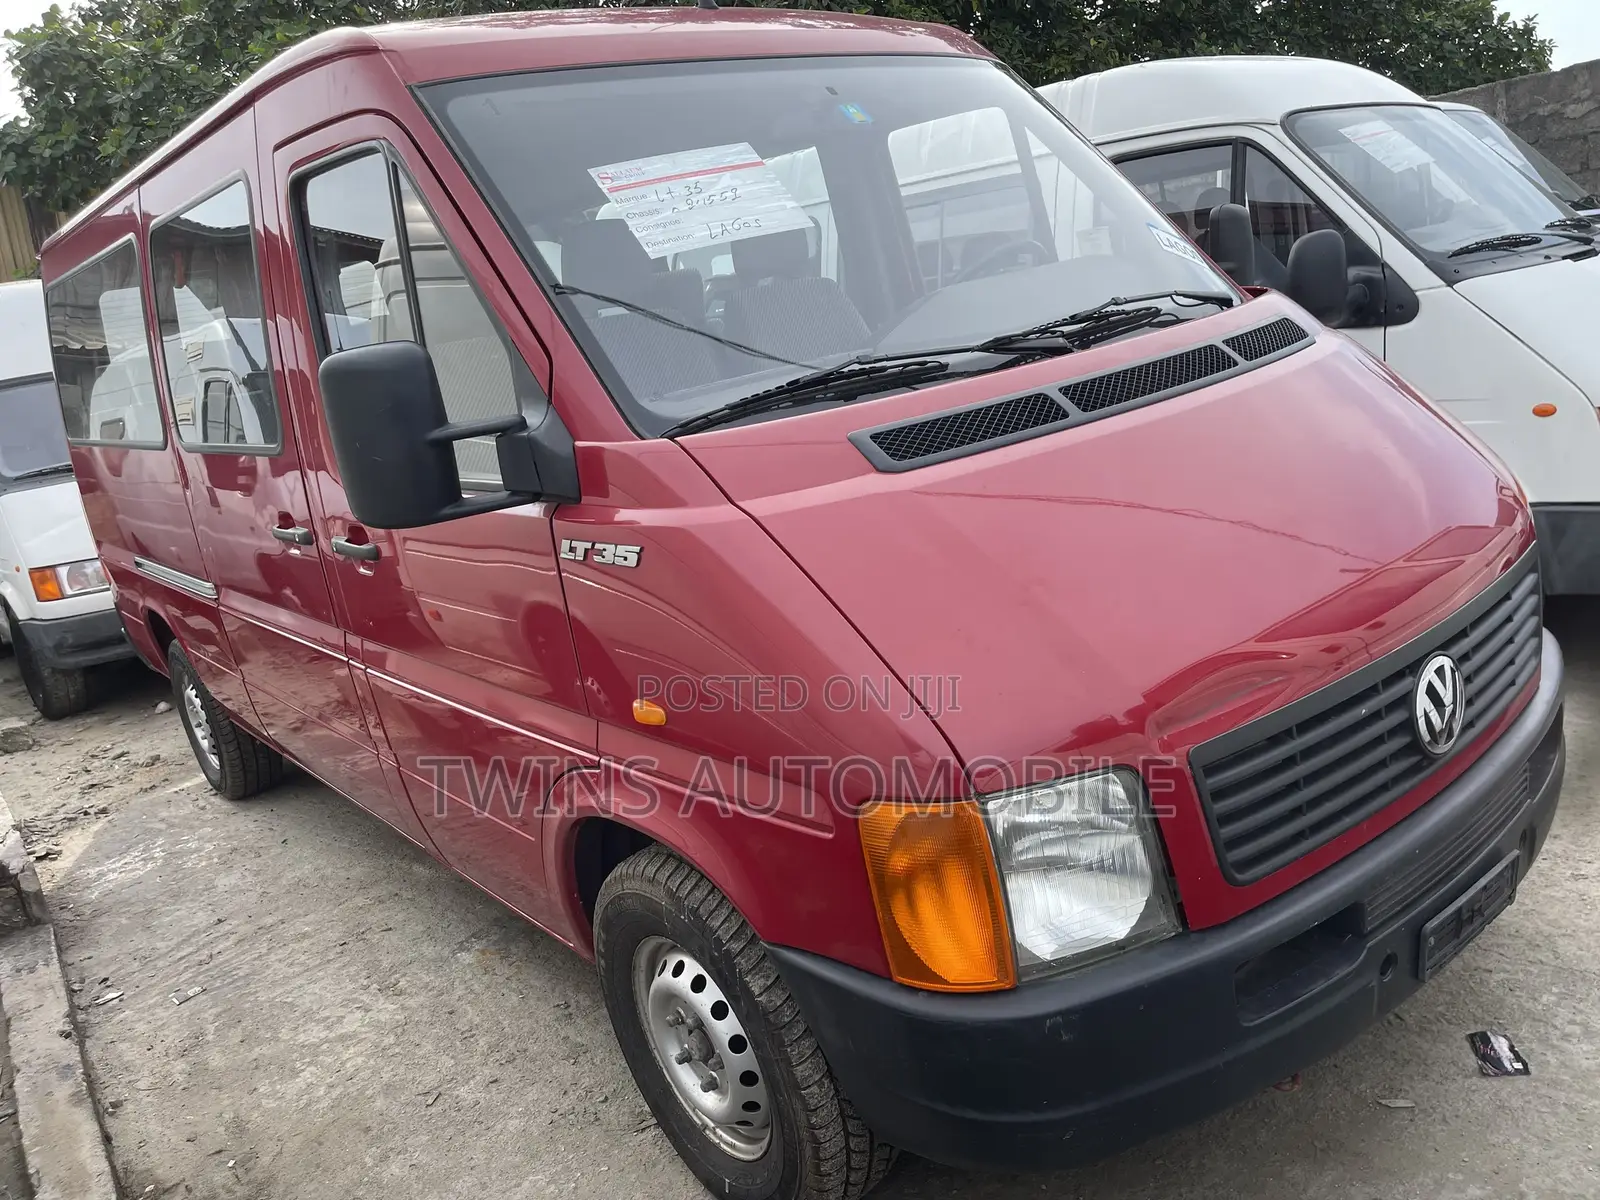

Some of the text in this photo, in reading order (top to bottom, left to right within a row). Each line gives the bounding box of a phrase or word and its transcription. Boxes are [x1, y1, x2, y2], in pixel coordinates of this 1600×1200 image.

[625, 207, 663, 220] Chassis:
[645, 232, 697, 249] Destination:
[559, 538, 643, 568] LT 35
